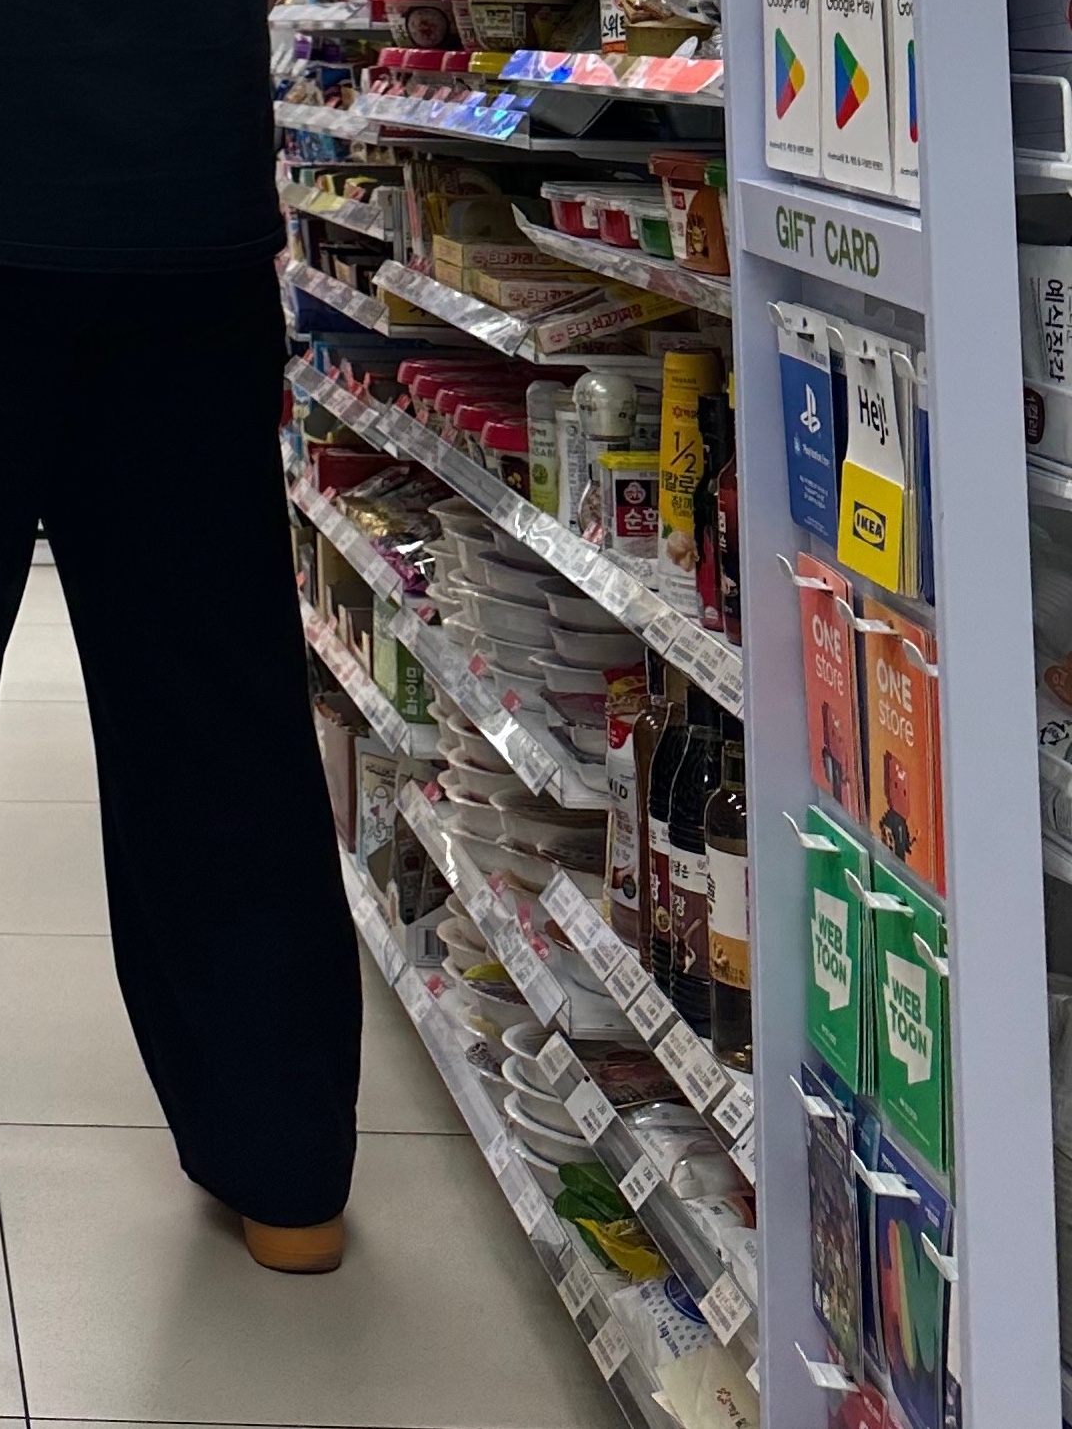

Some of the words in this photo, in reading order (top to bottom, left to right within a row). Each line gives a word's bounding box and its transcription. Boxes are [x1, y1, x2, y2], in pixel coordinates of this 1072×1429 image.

[776, 204, 816, 258] GIFT
[824, 220, 881, 278] CARD
[857, 385, 889, 446] Hej!
[857, 511, 885, 539] IKEA
[812, 614, 843, 665] ONE
[815, 652, 844, 697] store
[876, 657, 912, 714] ONE
[879, 698, 914, 748] store
[817, 912, 843, 956] WEB
[815, 940, 847, 987] TOON
[891, 976, 922, 1021] WEB
[889, 1008, 928, 1059] TOON
